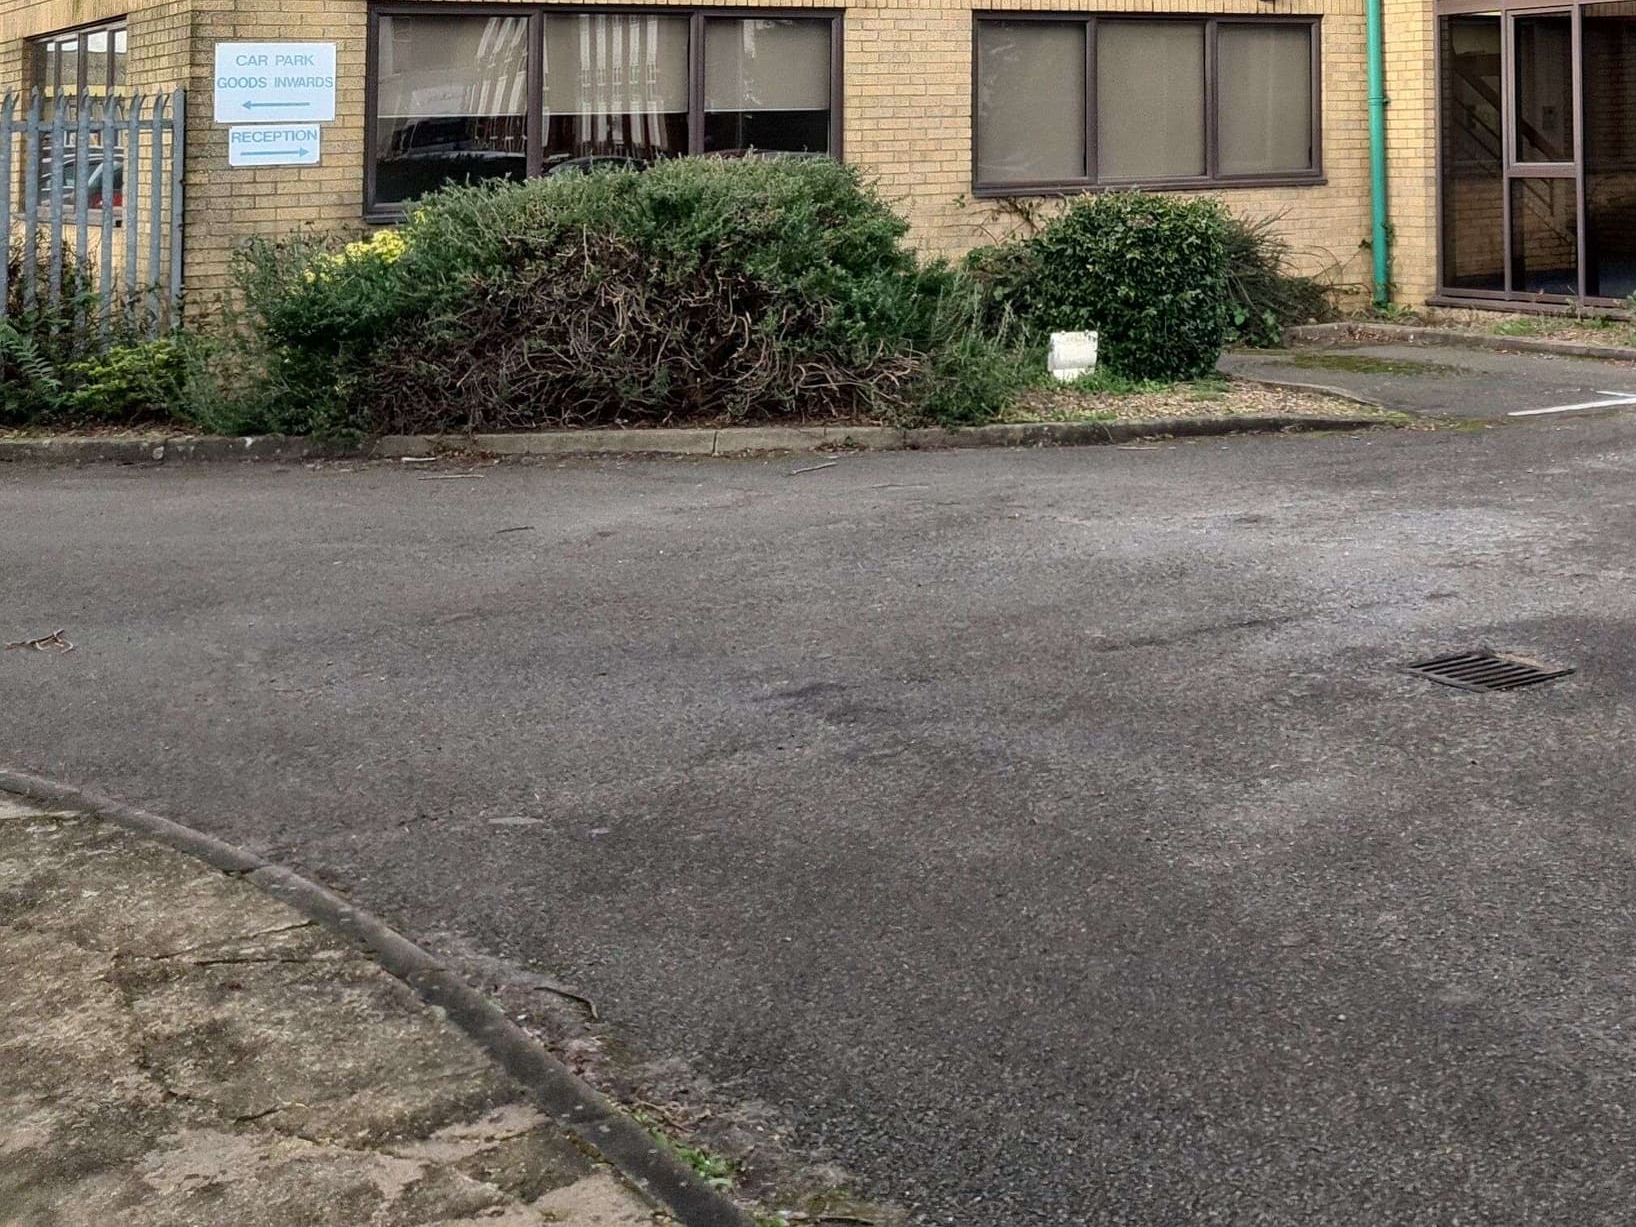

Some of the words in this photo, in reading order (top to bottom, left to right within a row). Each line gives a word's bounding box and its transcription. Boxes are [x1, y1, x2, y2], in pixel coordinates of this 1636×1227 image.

[236, 55, 268, 66] CAR
[275, 54, 315, 66] PARK
[217, 77, 267, 89] GOODS
[274, 76, 333, 88] INWARDS
[231, 129, 318, 143] RECEPTION
